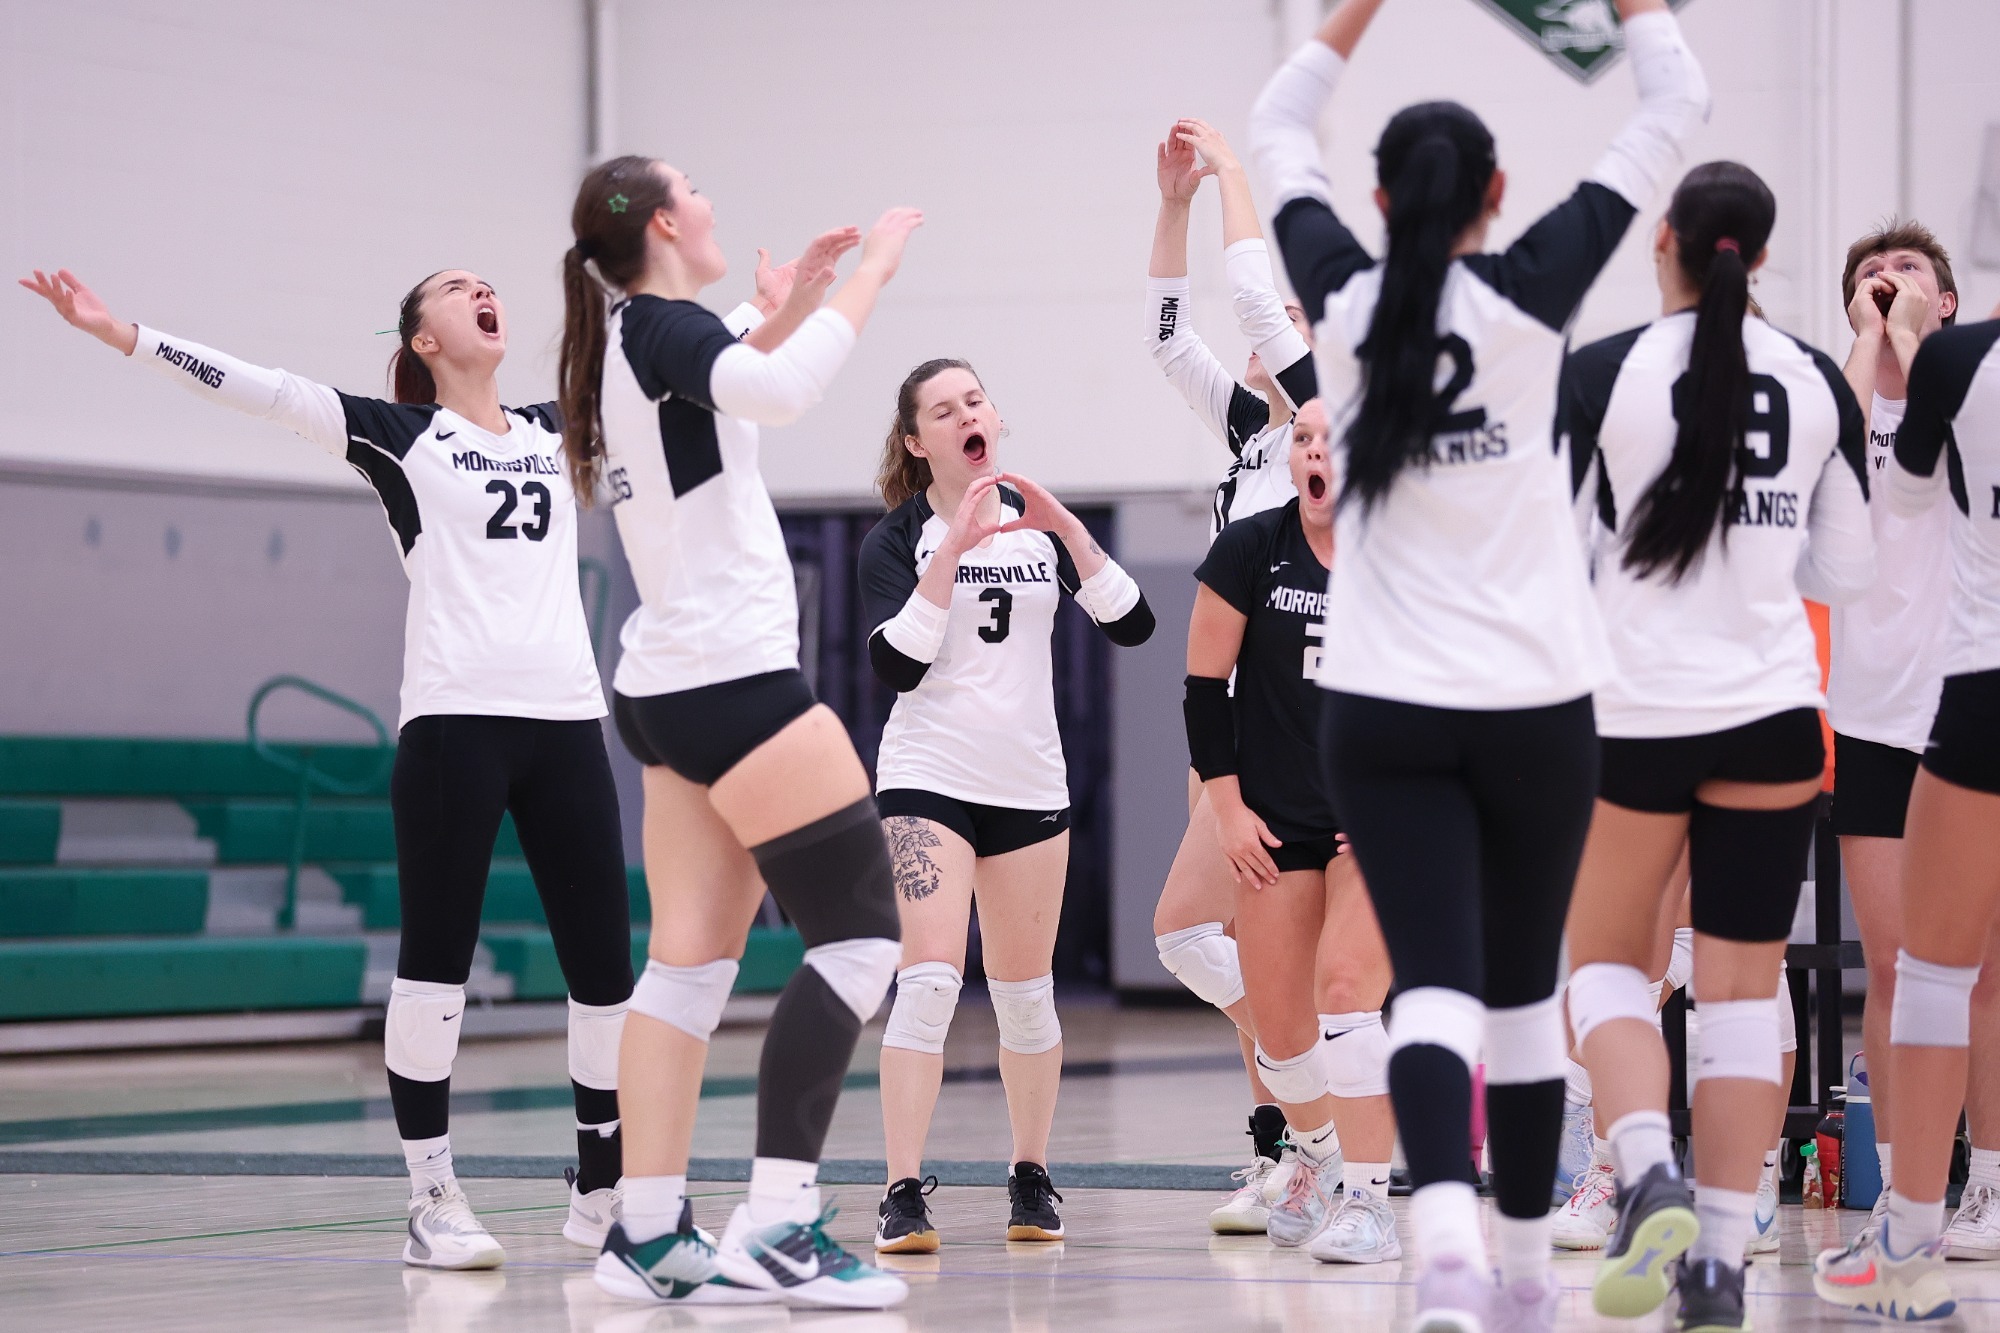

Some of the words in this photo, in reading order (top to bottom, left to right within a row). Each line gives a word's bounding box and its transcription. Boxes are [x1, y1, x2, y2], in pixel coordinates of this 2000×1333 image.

[155, 341, 226, 389] MUSTANGS
[485, 479, 552, 542] 23
[955, 562, 1052, 584] RRISVILLE
[977, 587, 1013, 644] 3
